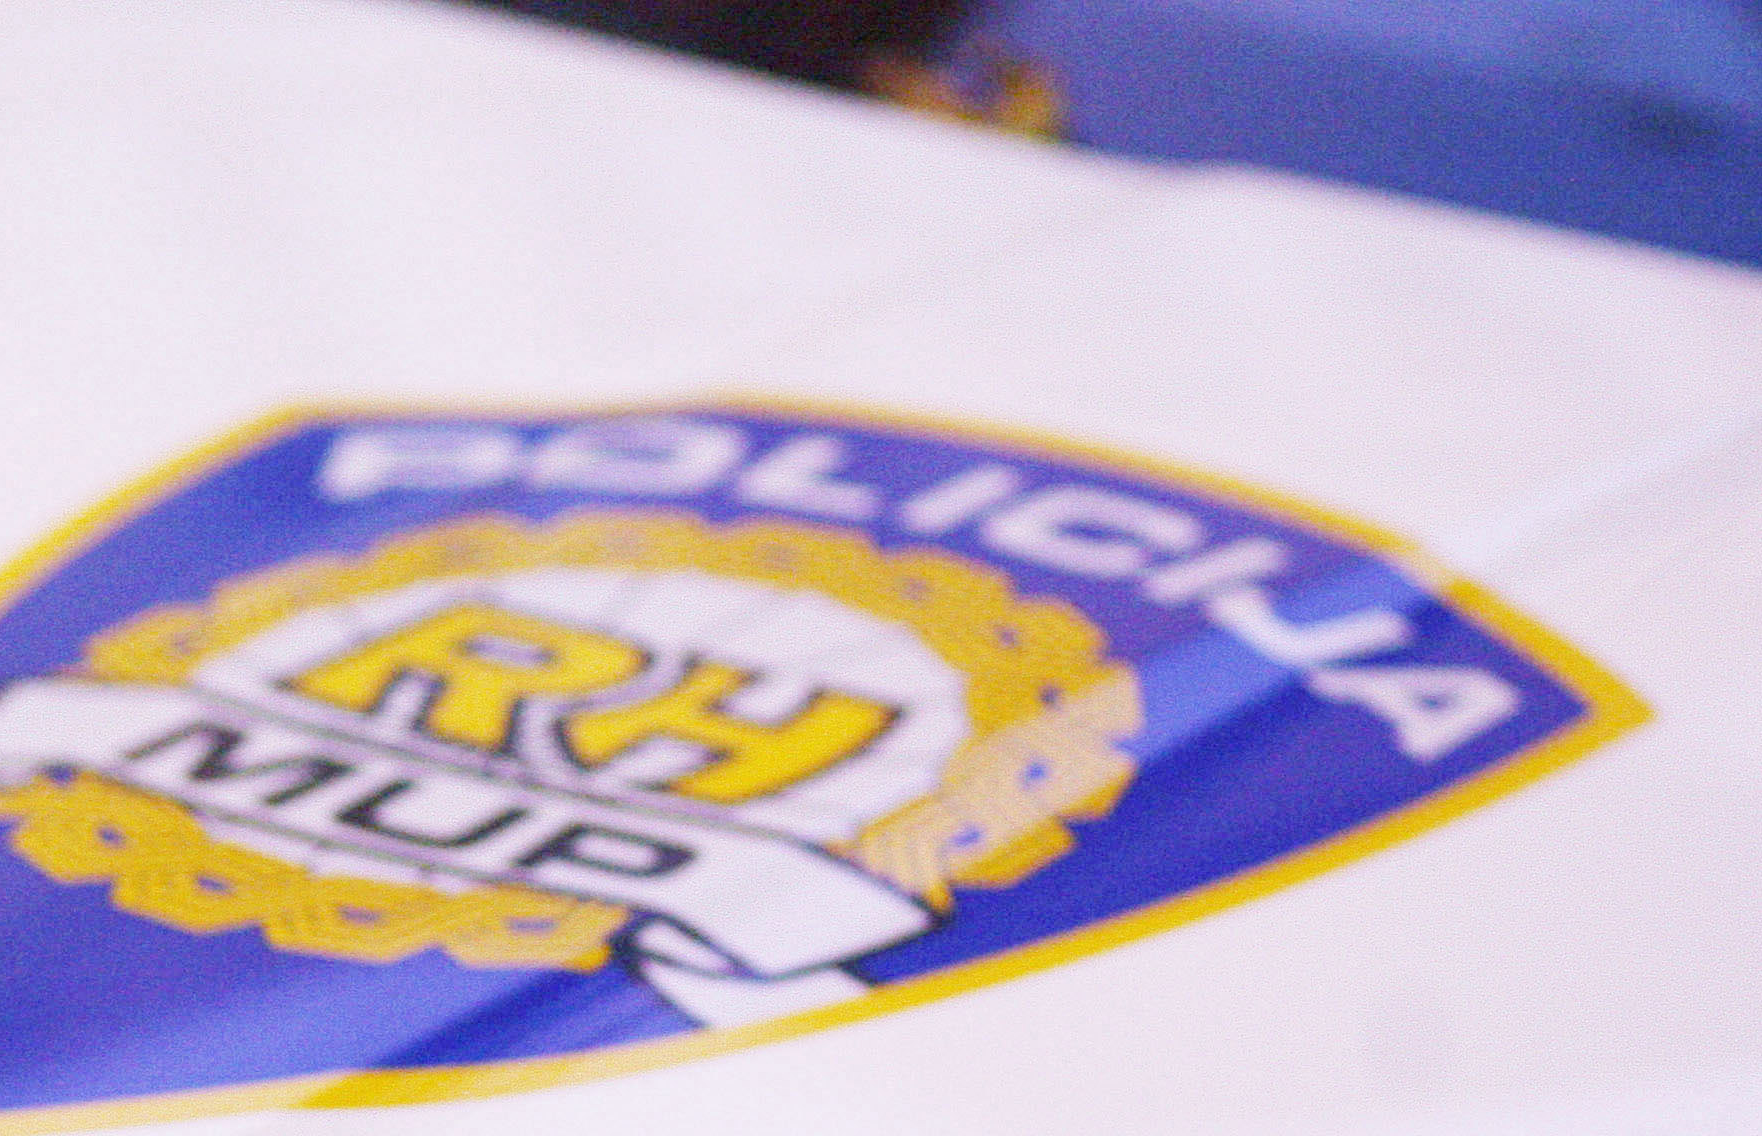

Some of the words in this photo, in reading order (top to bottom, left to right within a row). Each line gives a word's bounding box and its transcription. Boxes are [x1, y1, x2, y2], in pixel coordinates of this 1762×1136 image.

[314, 412, 1524, 763] POLICIJA
[122, 722, 700, 878] MUP
[273, 603, 908, 805] RH
